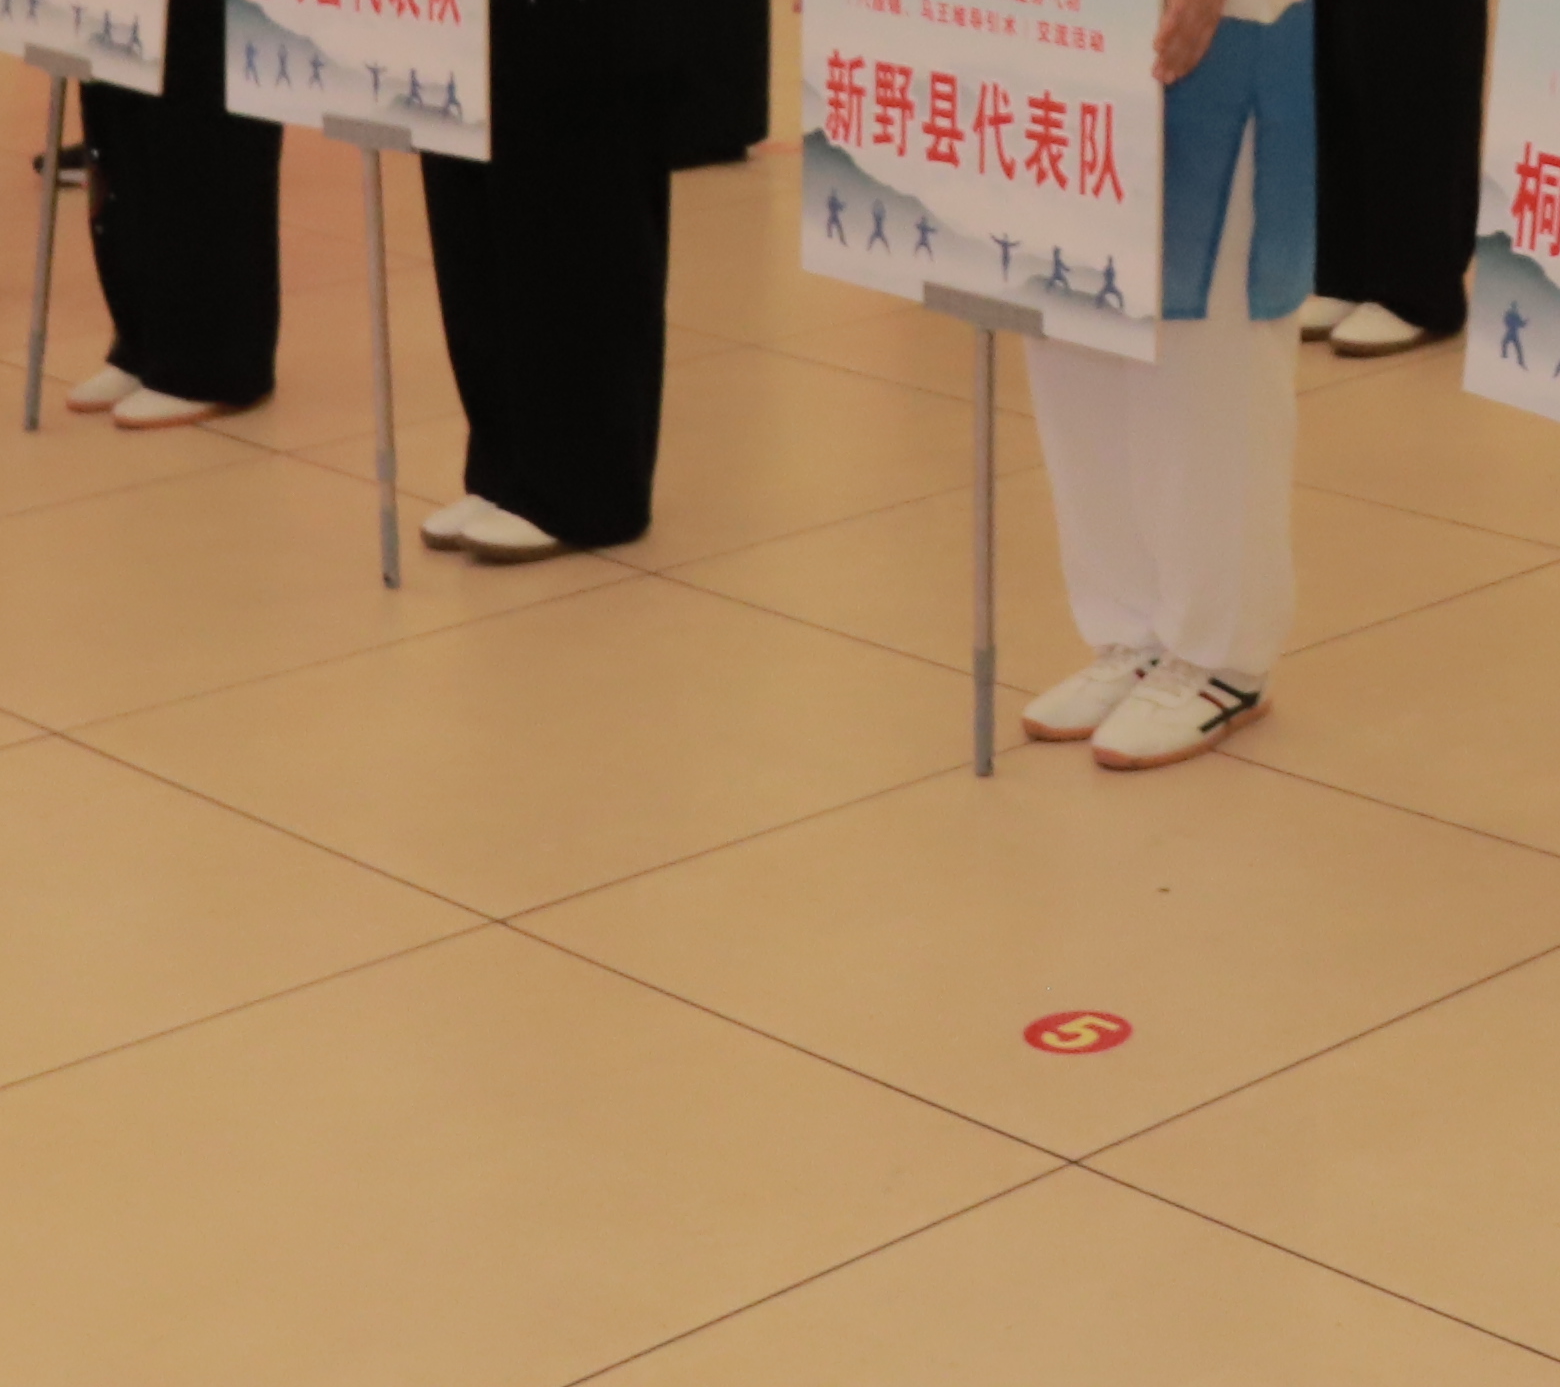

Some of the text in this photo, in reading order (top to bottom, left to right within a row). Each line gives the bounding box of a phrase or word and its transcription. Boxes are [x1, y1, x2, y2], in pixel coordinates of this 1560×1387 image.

[824, 49, 1125, 203] 新野县代表队
[1040, 1015, 1120, 1048] 5
